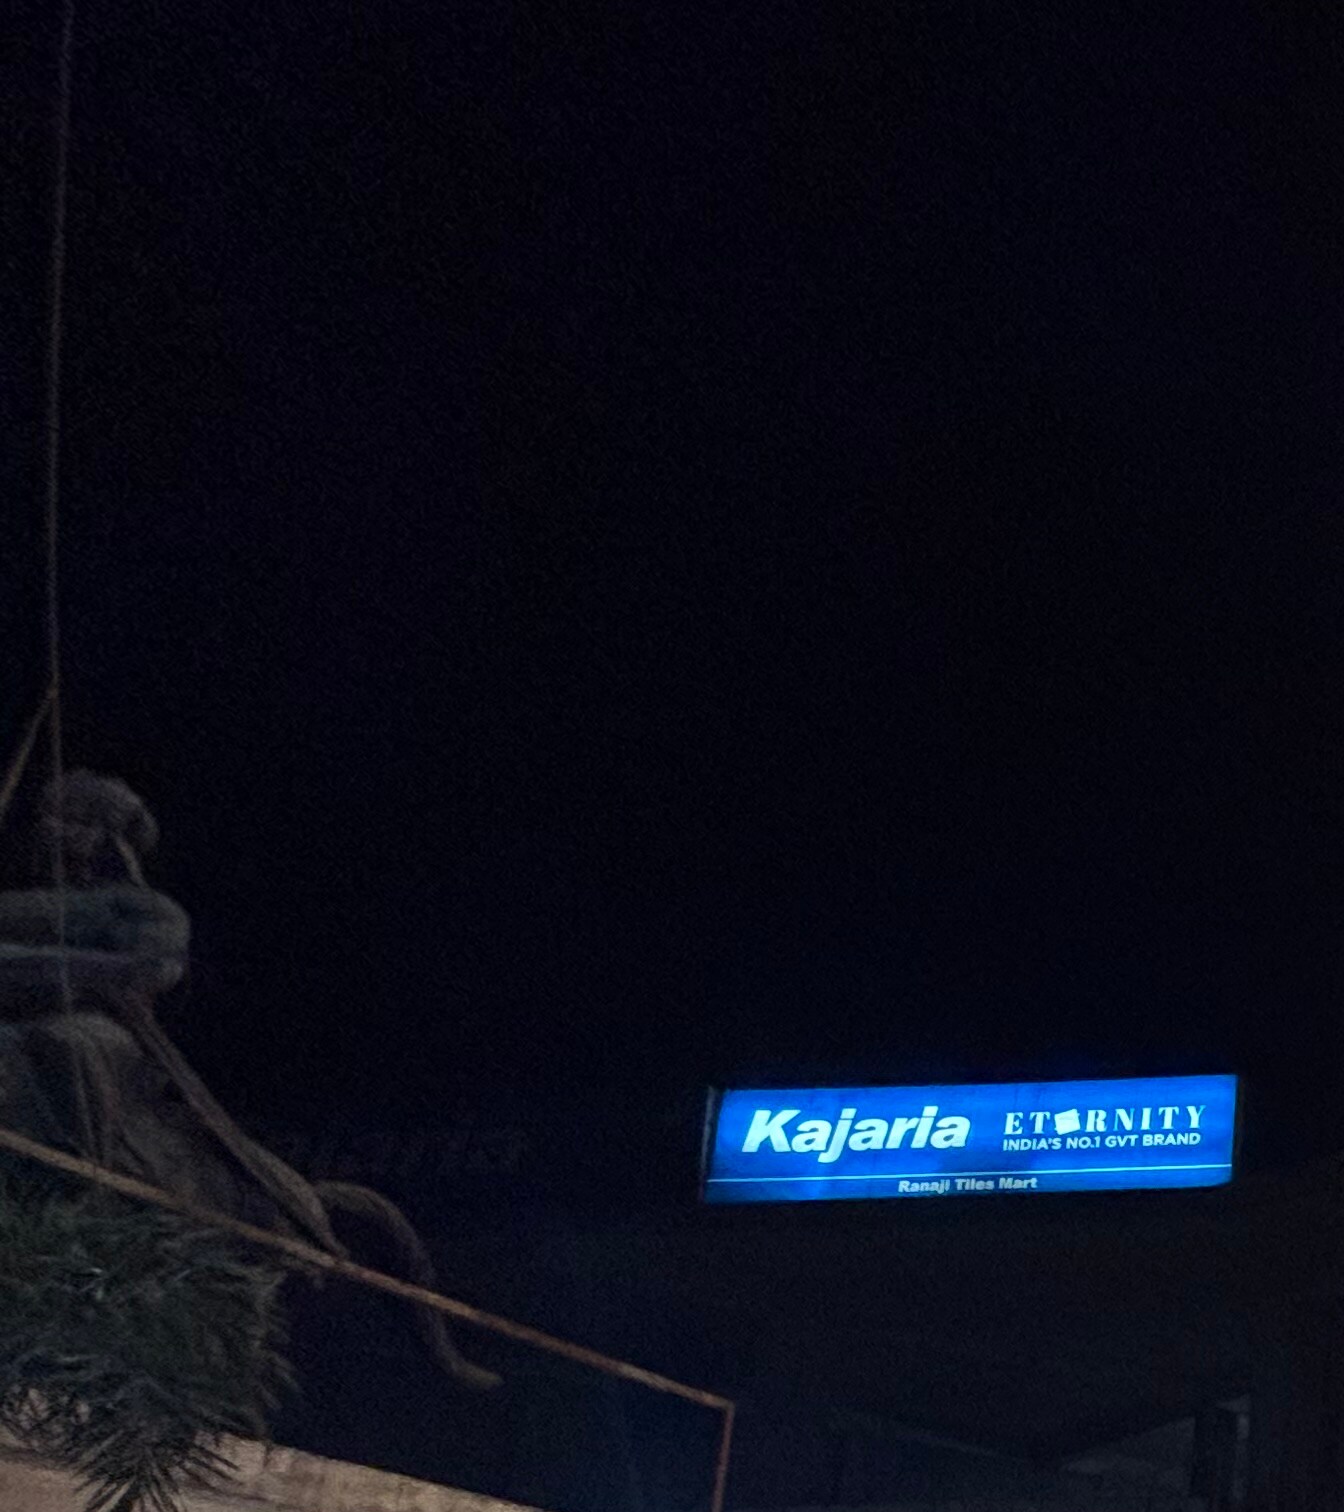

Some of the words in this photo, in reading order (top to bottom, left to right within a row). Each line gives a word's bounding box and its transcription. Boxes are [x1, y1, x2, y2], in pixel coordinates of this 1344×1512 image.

[741, 1106, 970, 1163] Kajaria
[1004, 1105, 1206, 1136] ETRNITY
[1003, 1137, 1061, 1151] INDIA'S
[1066, 1136, 1100, 1149] NO.1
[1105, 1134, 1139, 1148] GVT
[1143, 1132, 1201, 1147] BRAND
[955, 1178, 995, 1191] Tiles
[998, 1177, 1038, 1189] Mart
